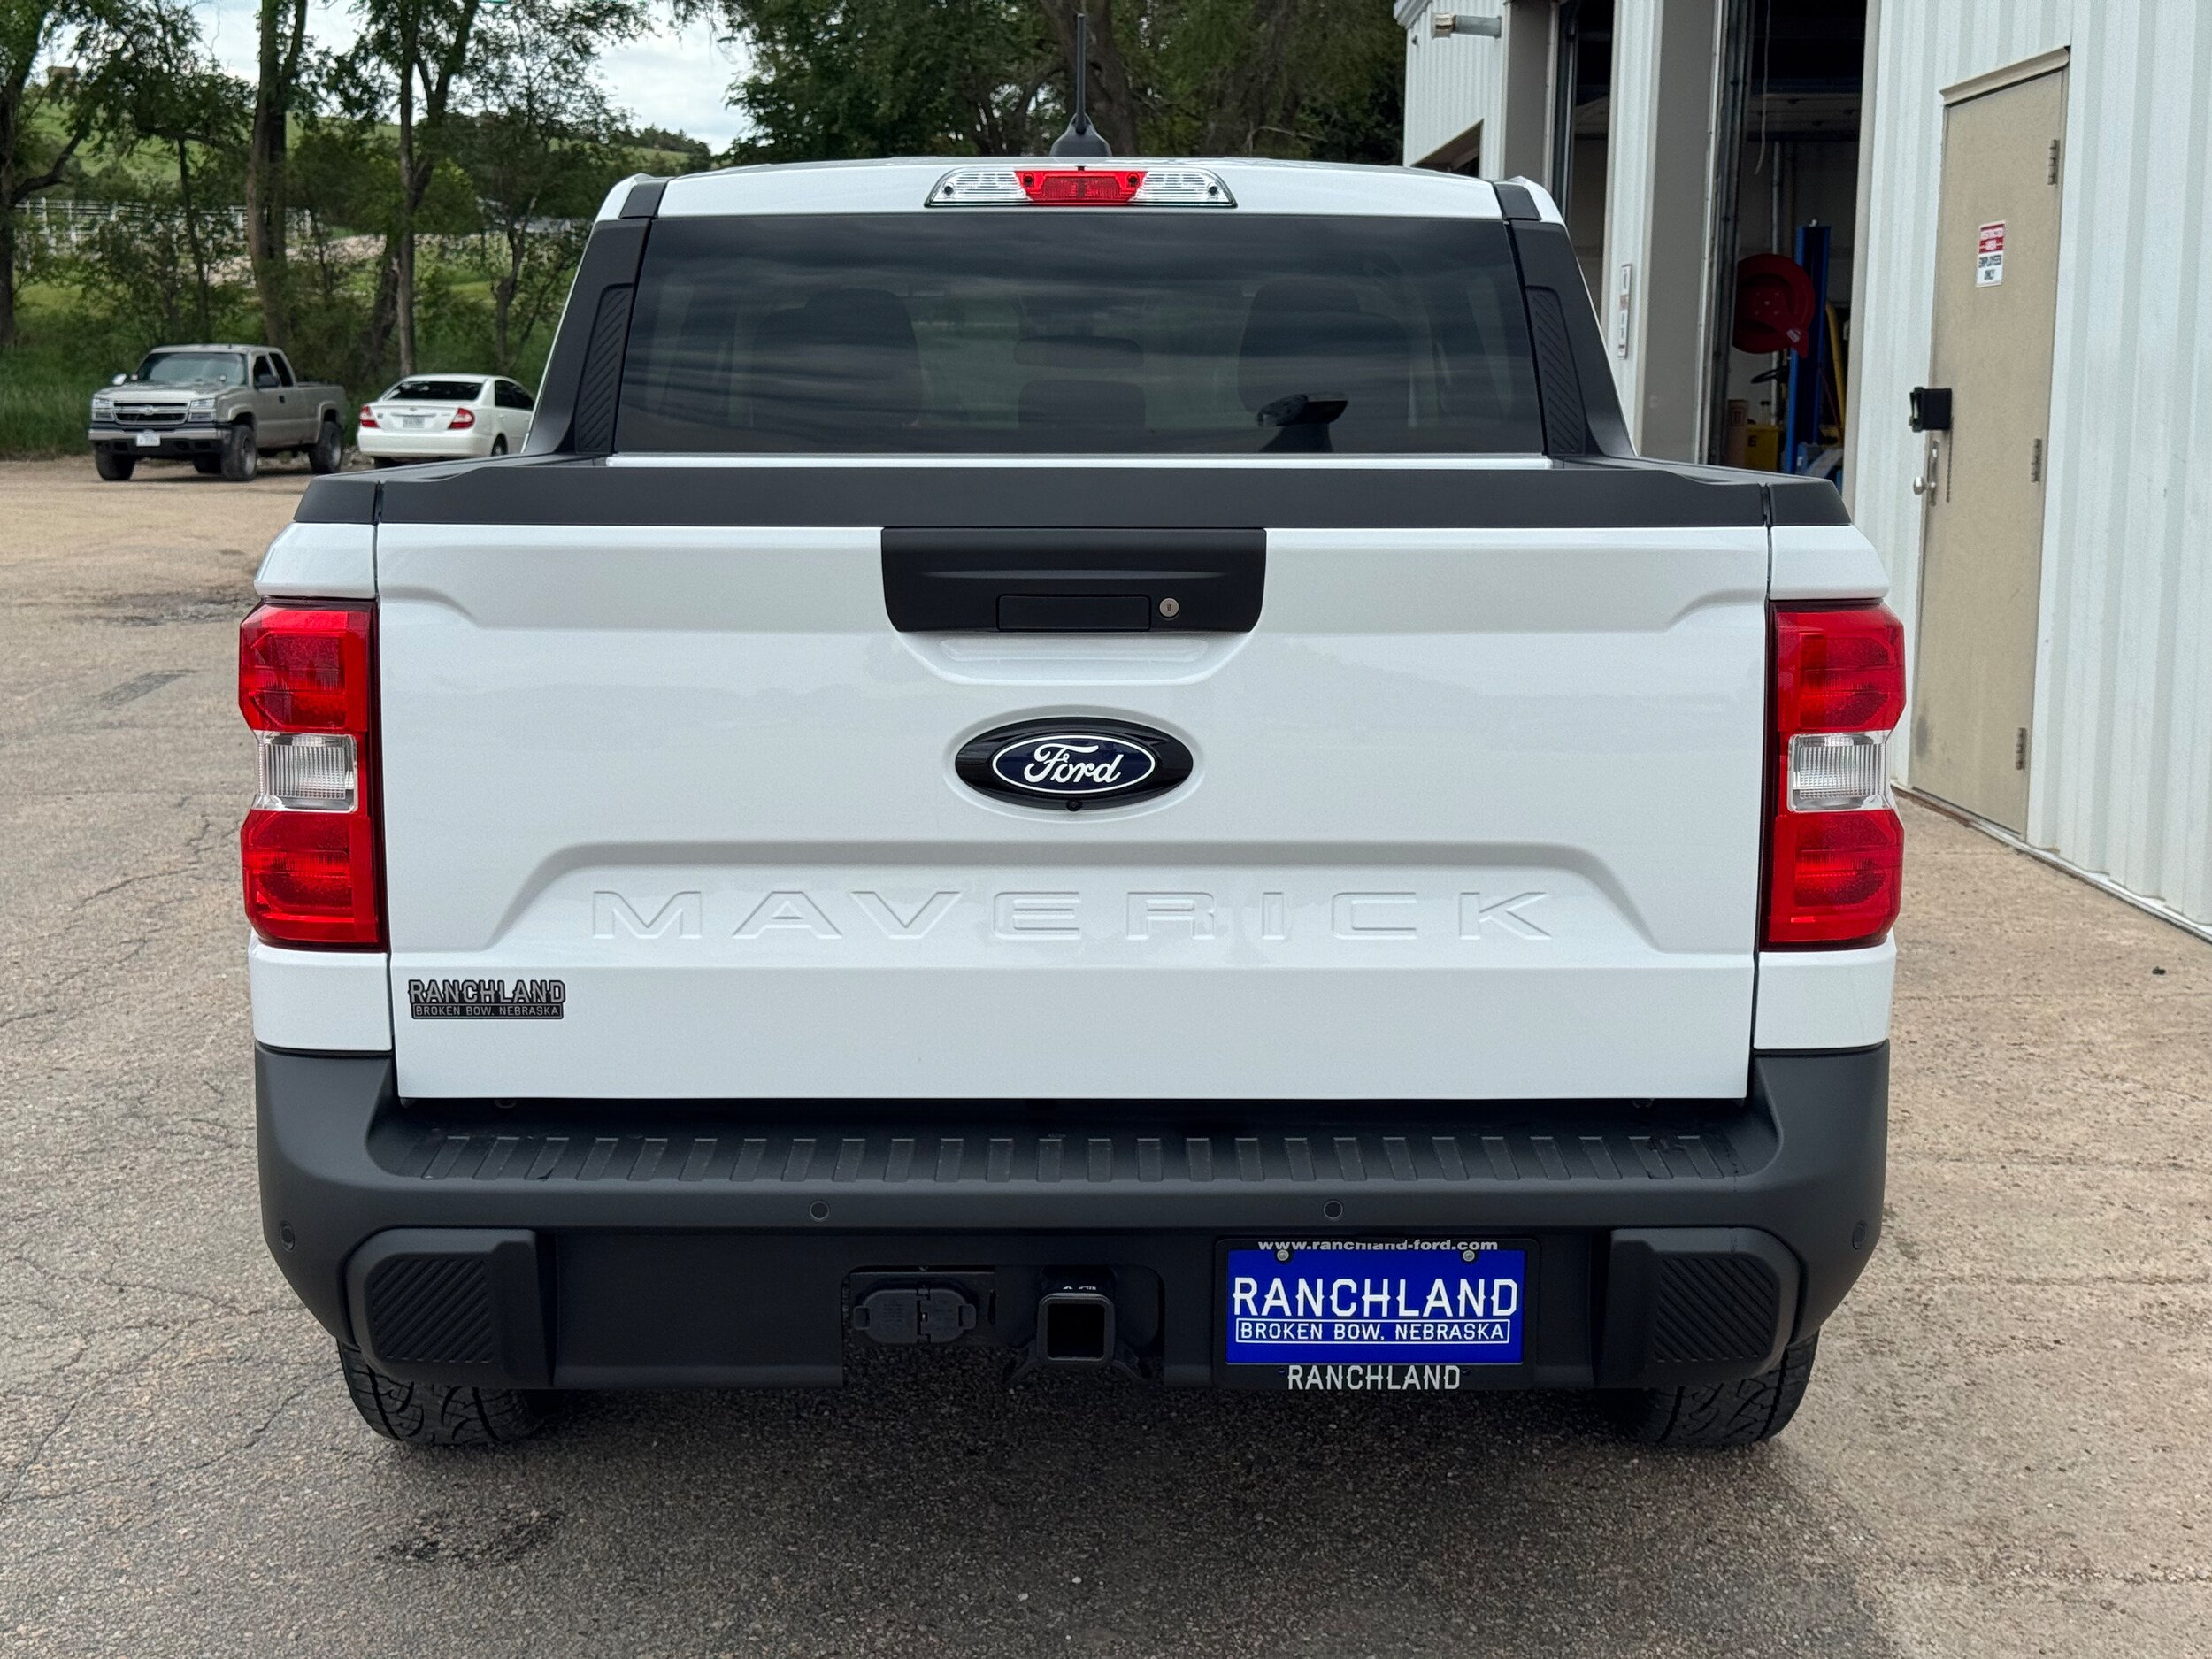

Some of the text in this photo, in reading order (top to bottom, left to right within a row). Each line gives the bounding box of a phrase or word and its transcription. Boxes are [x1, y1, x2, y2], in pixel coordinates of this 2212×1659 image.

[1024, 743, 1124, 783] Ford
[592, 890, 1552, 940] MAVERICK
[409, 980, 565, 1003] RANCHLAND
[415, 1005, 461, 1017] BROKEN
[499, 1005, 559, 1017] NEBRASKA
[1233, 1277, 1518, 1317] RANCHLAND
[1240, 1322, 1504, 1341] BROKEN BOW, NEBRASKA
[1287, 1364, 1461, 1390] RANCHLAND
